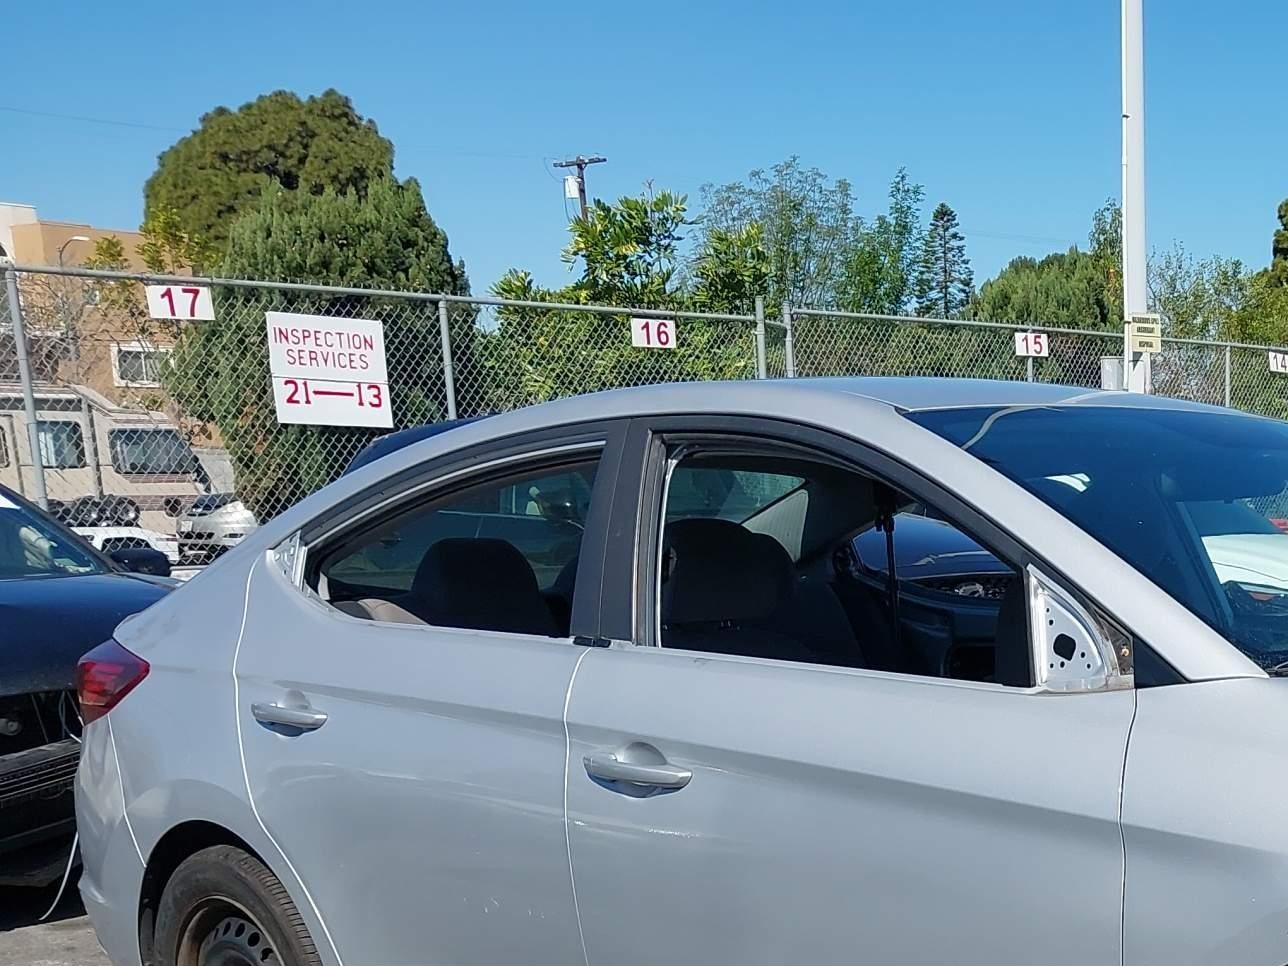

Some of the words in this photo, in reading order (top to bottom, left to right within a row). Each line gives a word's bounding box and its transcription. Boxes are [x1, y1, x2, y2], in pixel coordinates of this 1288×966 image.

[160, 287, 201, 317] 17
[273, 326, 375, 351] INSPECTION
[640, 321, 669, 346] 16
[1022, 334, 1043, 355] 15
[286, 349, 370, 370] SERVICES
[1273, 353, 1287, 371] 14
